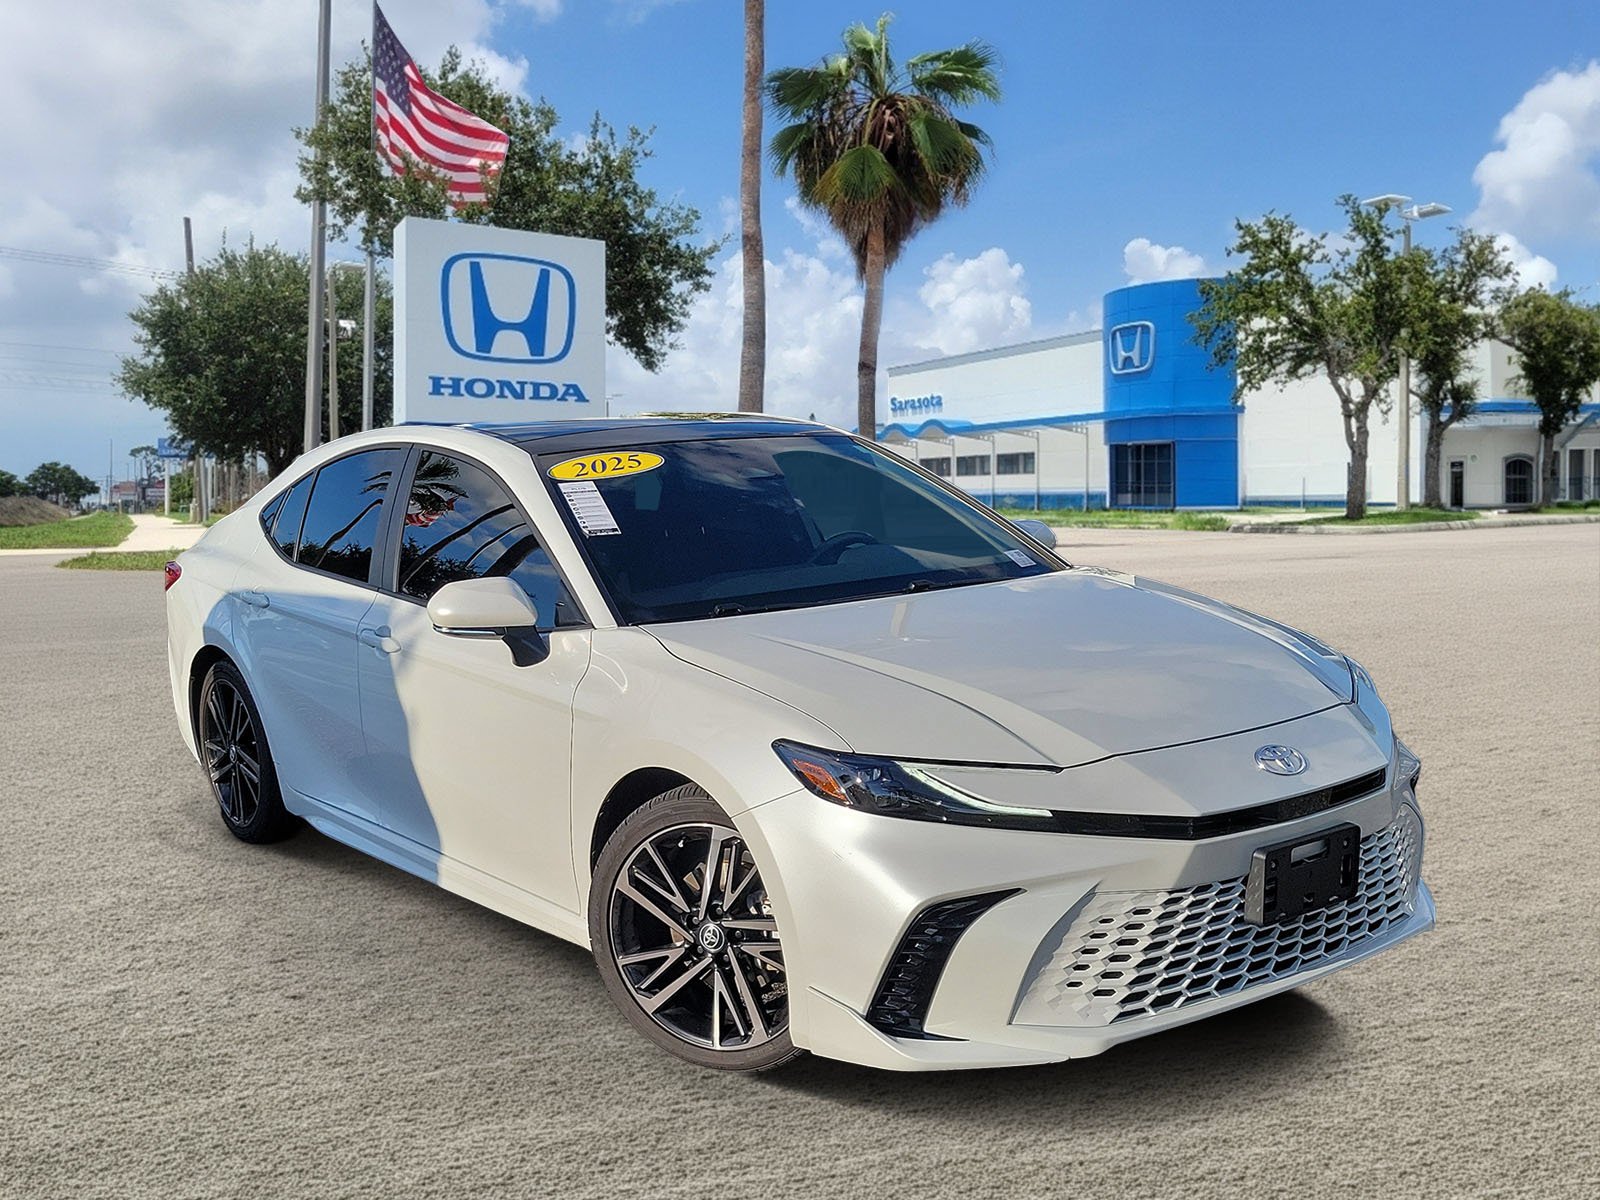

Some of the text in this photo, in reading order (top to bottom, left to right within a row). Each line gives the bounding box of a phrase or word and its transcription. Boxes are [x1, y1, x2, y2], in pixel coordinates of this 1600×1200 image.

[428, 375, 590, 403] HONDA
[890, 393, 943, 411] Sarasota
[572, 454, 642, 478] 2025
